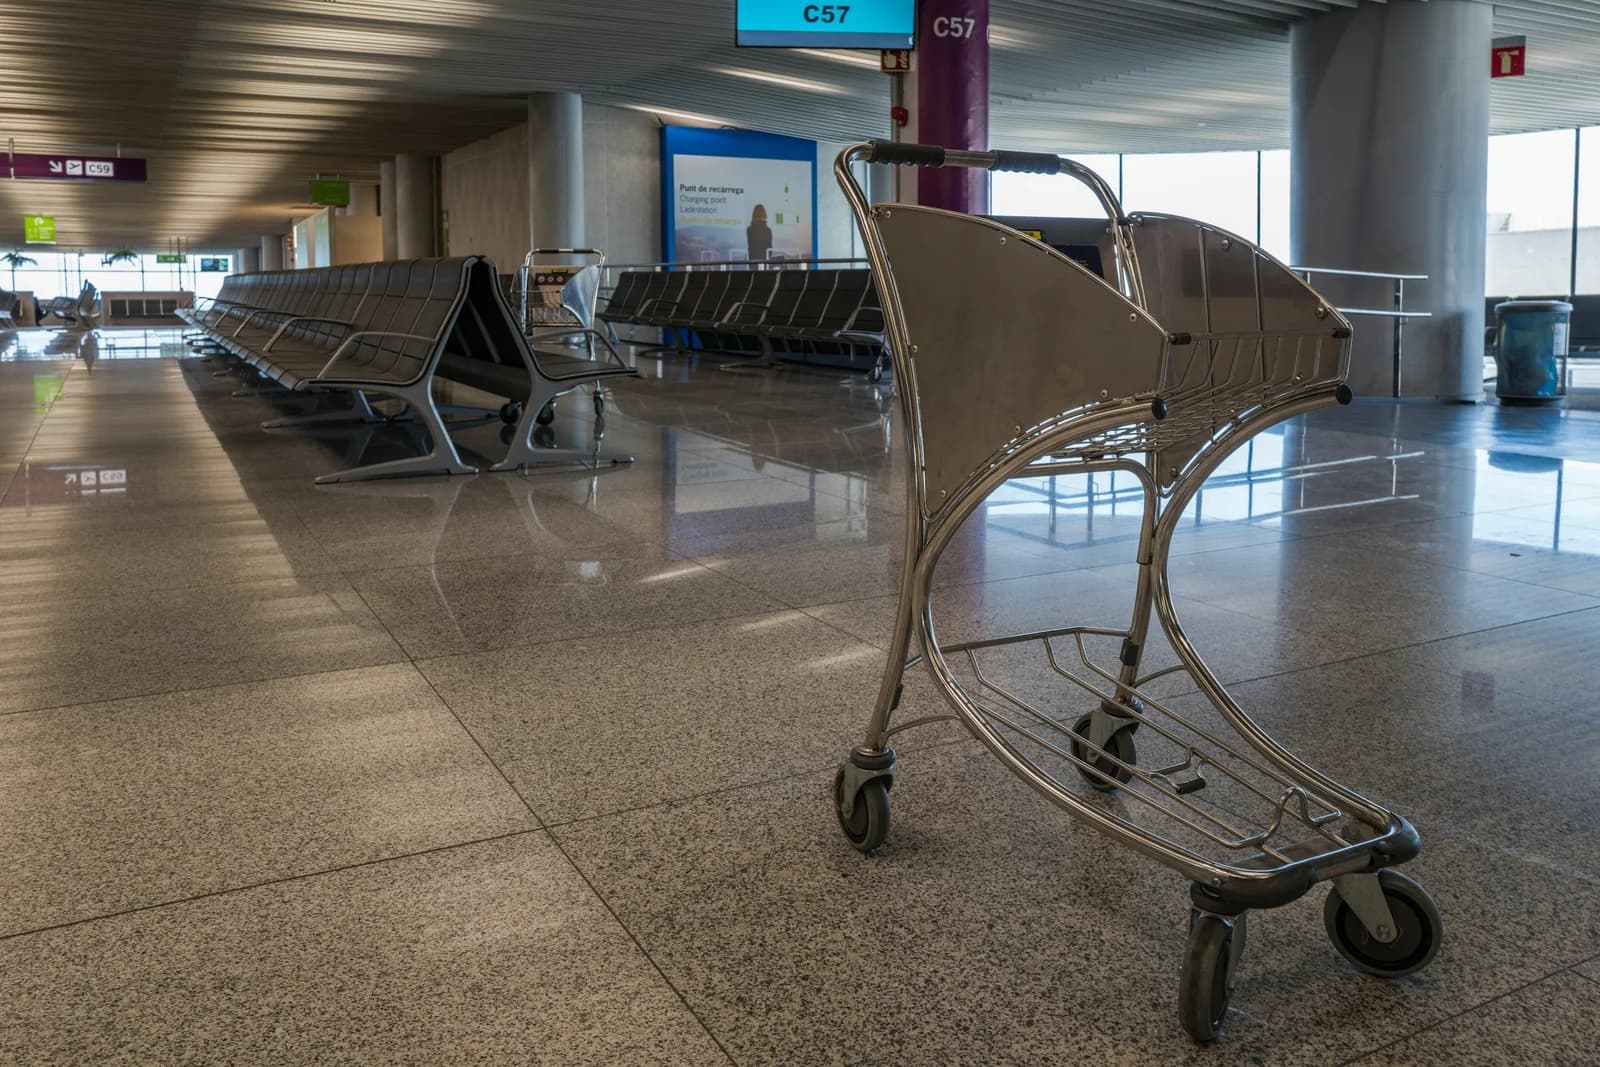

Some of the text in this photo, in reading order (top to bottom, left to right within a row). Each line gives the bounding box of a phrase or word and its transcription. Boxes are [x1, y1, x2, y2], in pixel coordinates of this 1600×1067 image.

[803, 5, 850, 23] C57
[933, 17, 976, 39] C57
[88, 163, 110, 174] C59
[680, 184, 697, 192] Punt
[698, 184, 707, 193] de
[680, 195, 727, 204] Charging point
[680, 206, 717, 214] Ladestation
